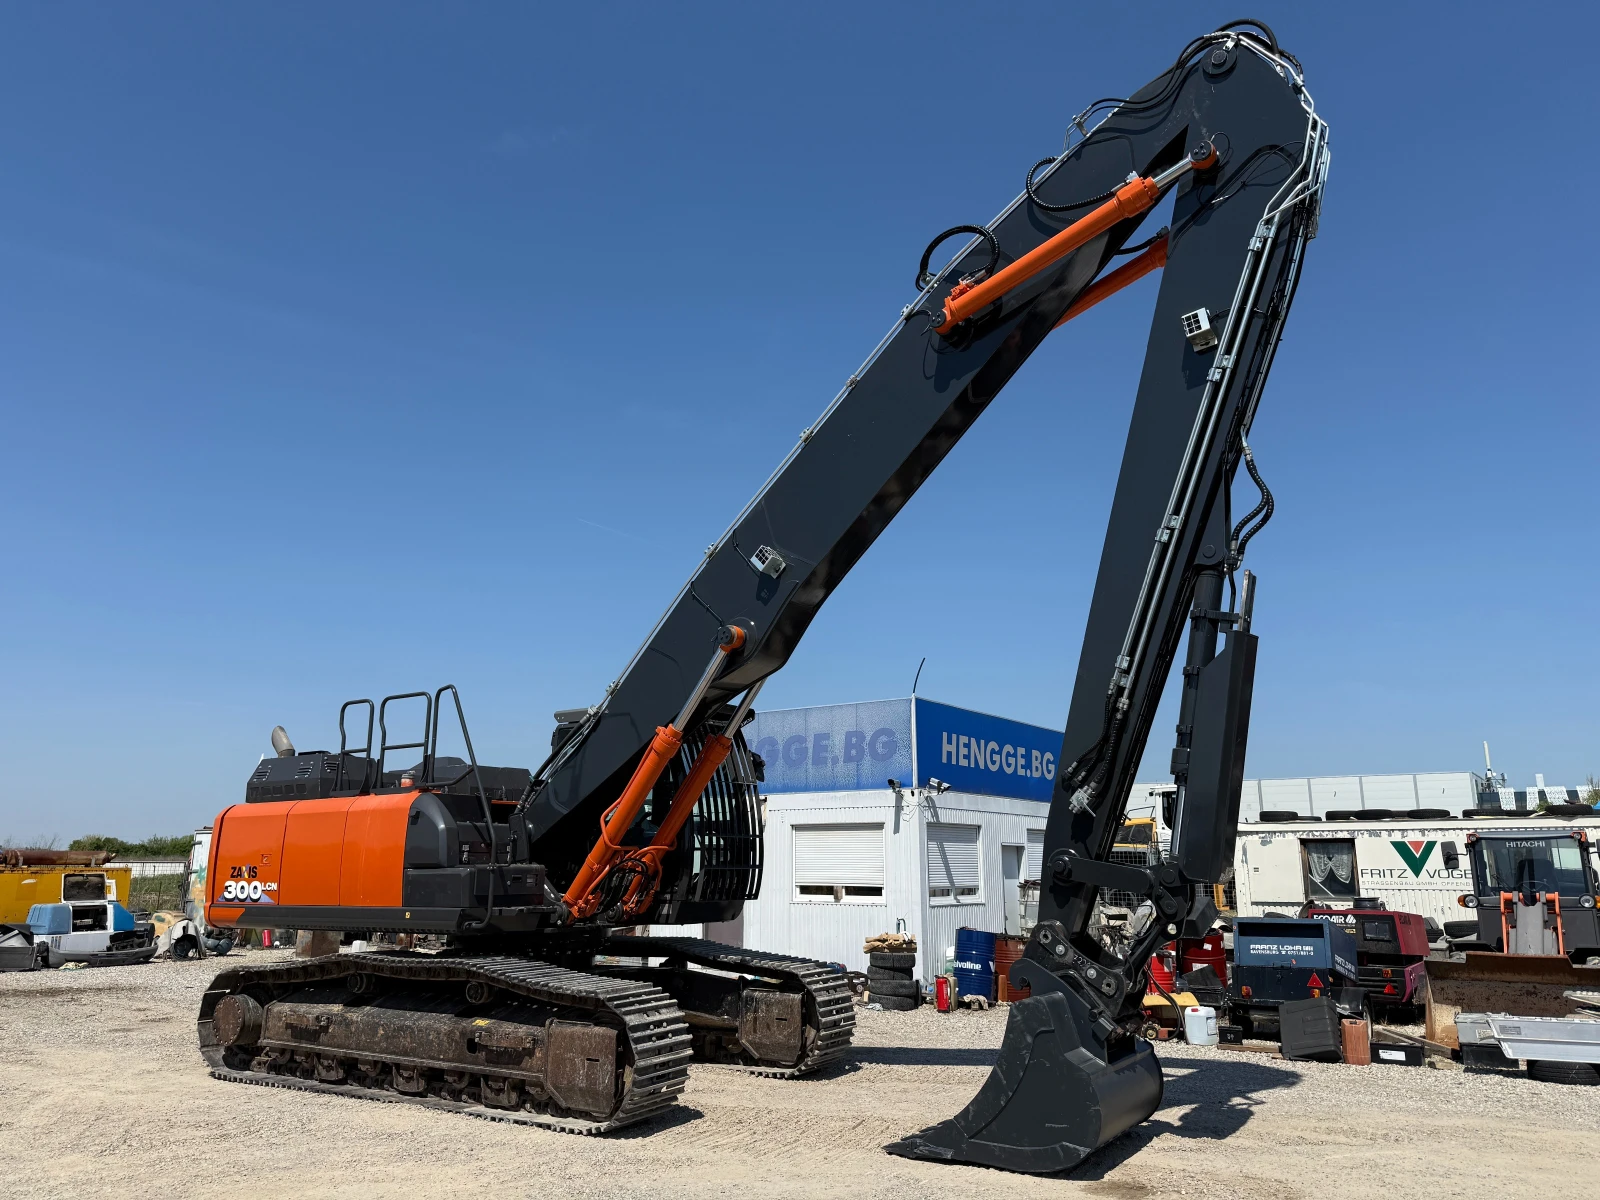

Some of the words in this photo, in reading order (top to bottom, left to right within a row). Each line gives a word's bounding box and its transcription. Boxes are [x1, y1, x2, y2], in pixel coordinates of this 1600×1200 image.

[748, 728, 898, 768] GGE.BG
[941, 731, 1056, 781] HENGGE.BG
[1505, 840, 1546, 848] HITACHI
[1360, 868, 1409, 879] FRITZ
[1425, 868, 1473, 879] VOGE
